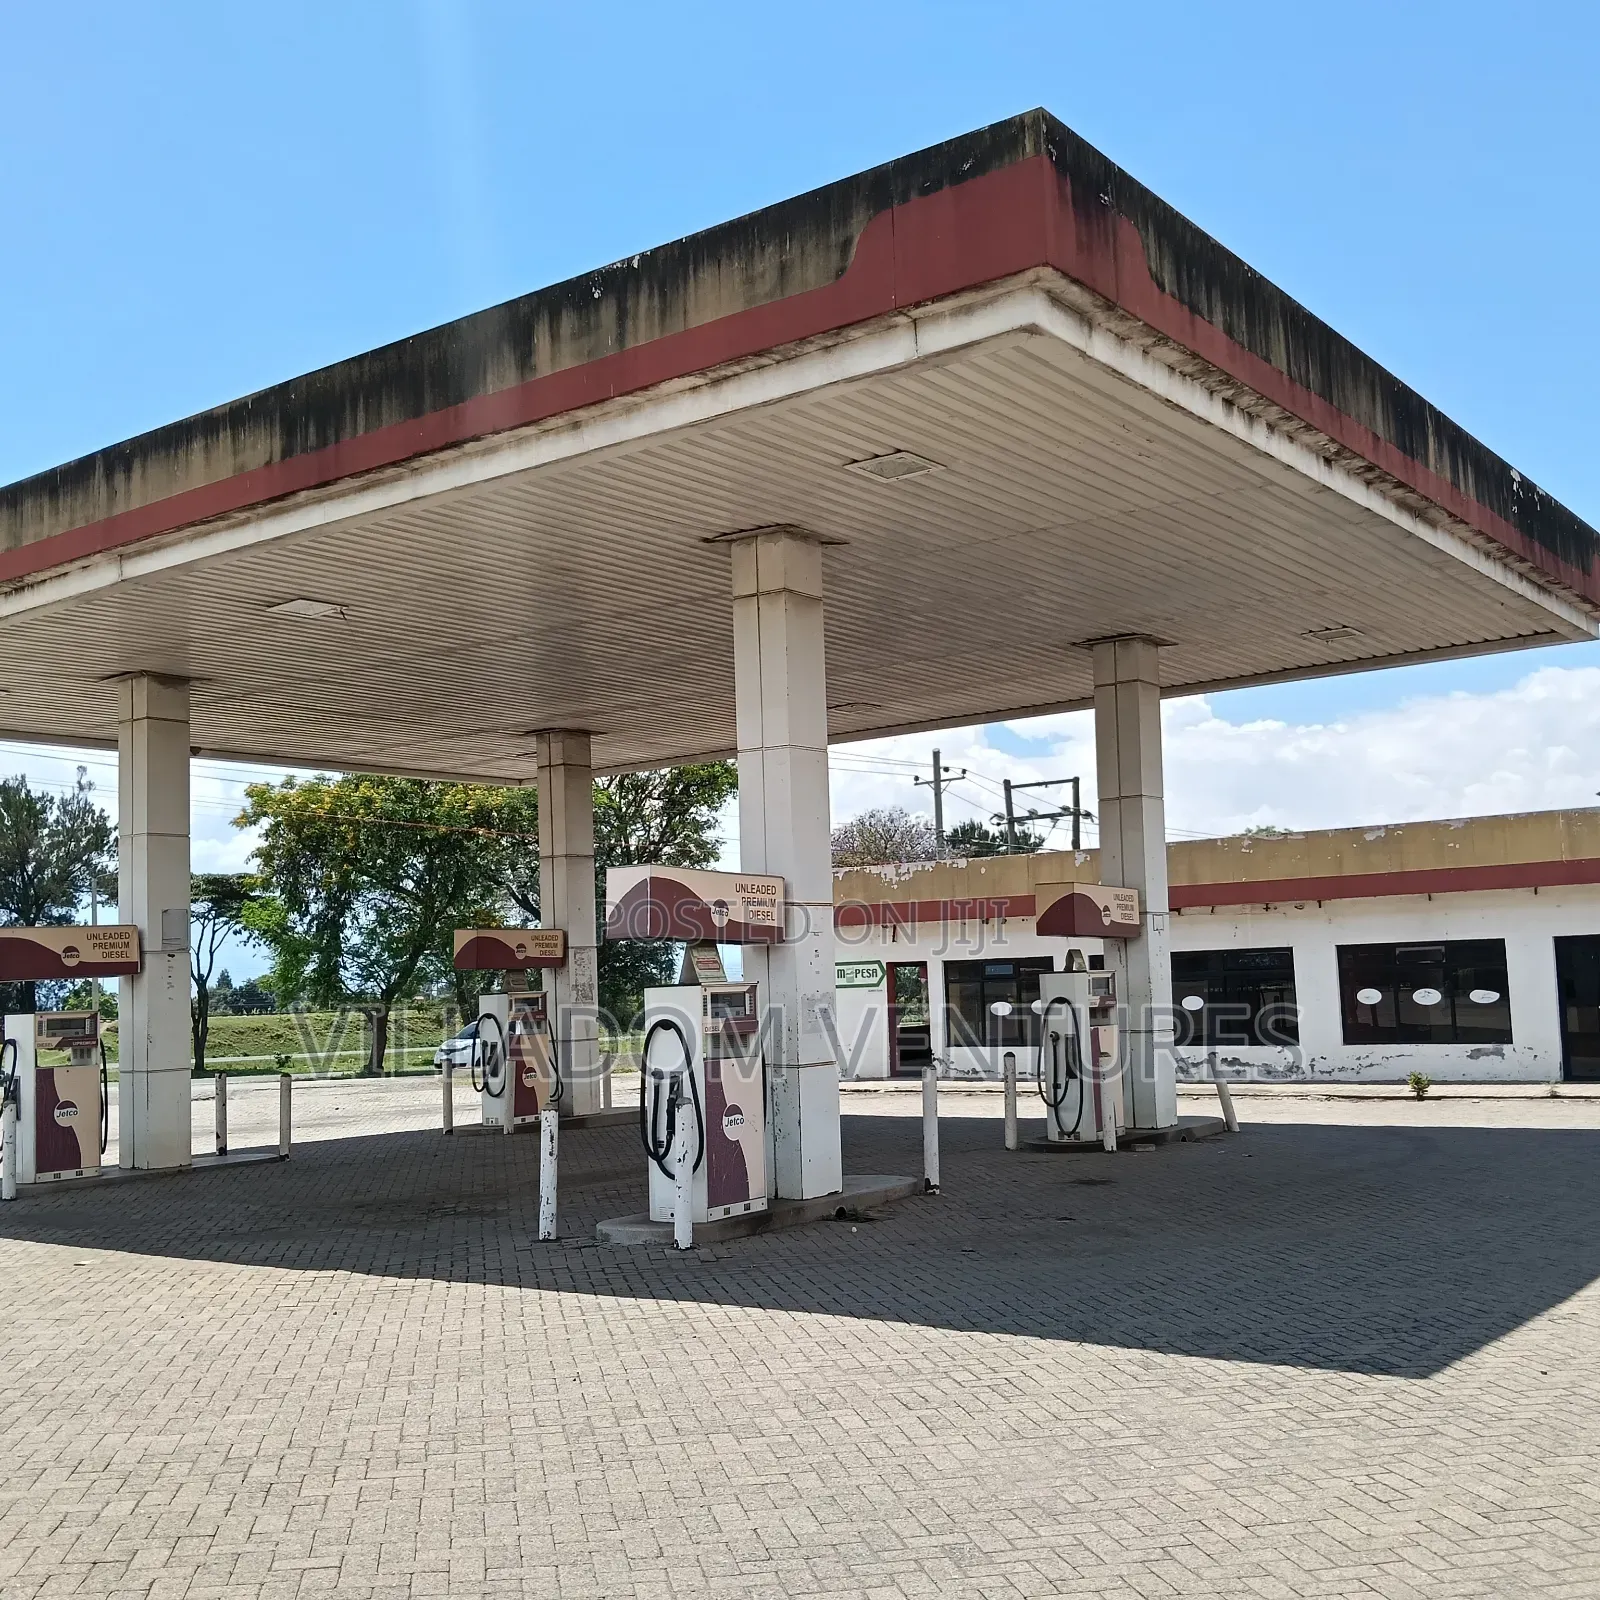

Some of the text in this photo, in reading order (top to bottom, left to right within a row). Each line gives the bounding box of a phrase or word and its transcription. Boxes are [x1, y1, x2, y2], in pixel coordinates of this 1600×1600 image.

[735, 883, 776, 895] UNLEADED
[741, 897, 776, 907] PREMIUM
[1113, 894, 1134, 902] UNLEADED
[712, 908, 729, 917] Jetco
[749, 909, 776, 921] DIESEL
[86, 932, 131, 940] UNLEADED
[92, 941, 130, 950] PREMIUM
[523, 1072, 538, 1082] Jetco
[55, 1106, 79, 1119] Jetco
[724, 1114, 745, 1127] Jetco
